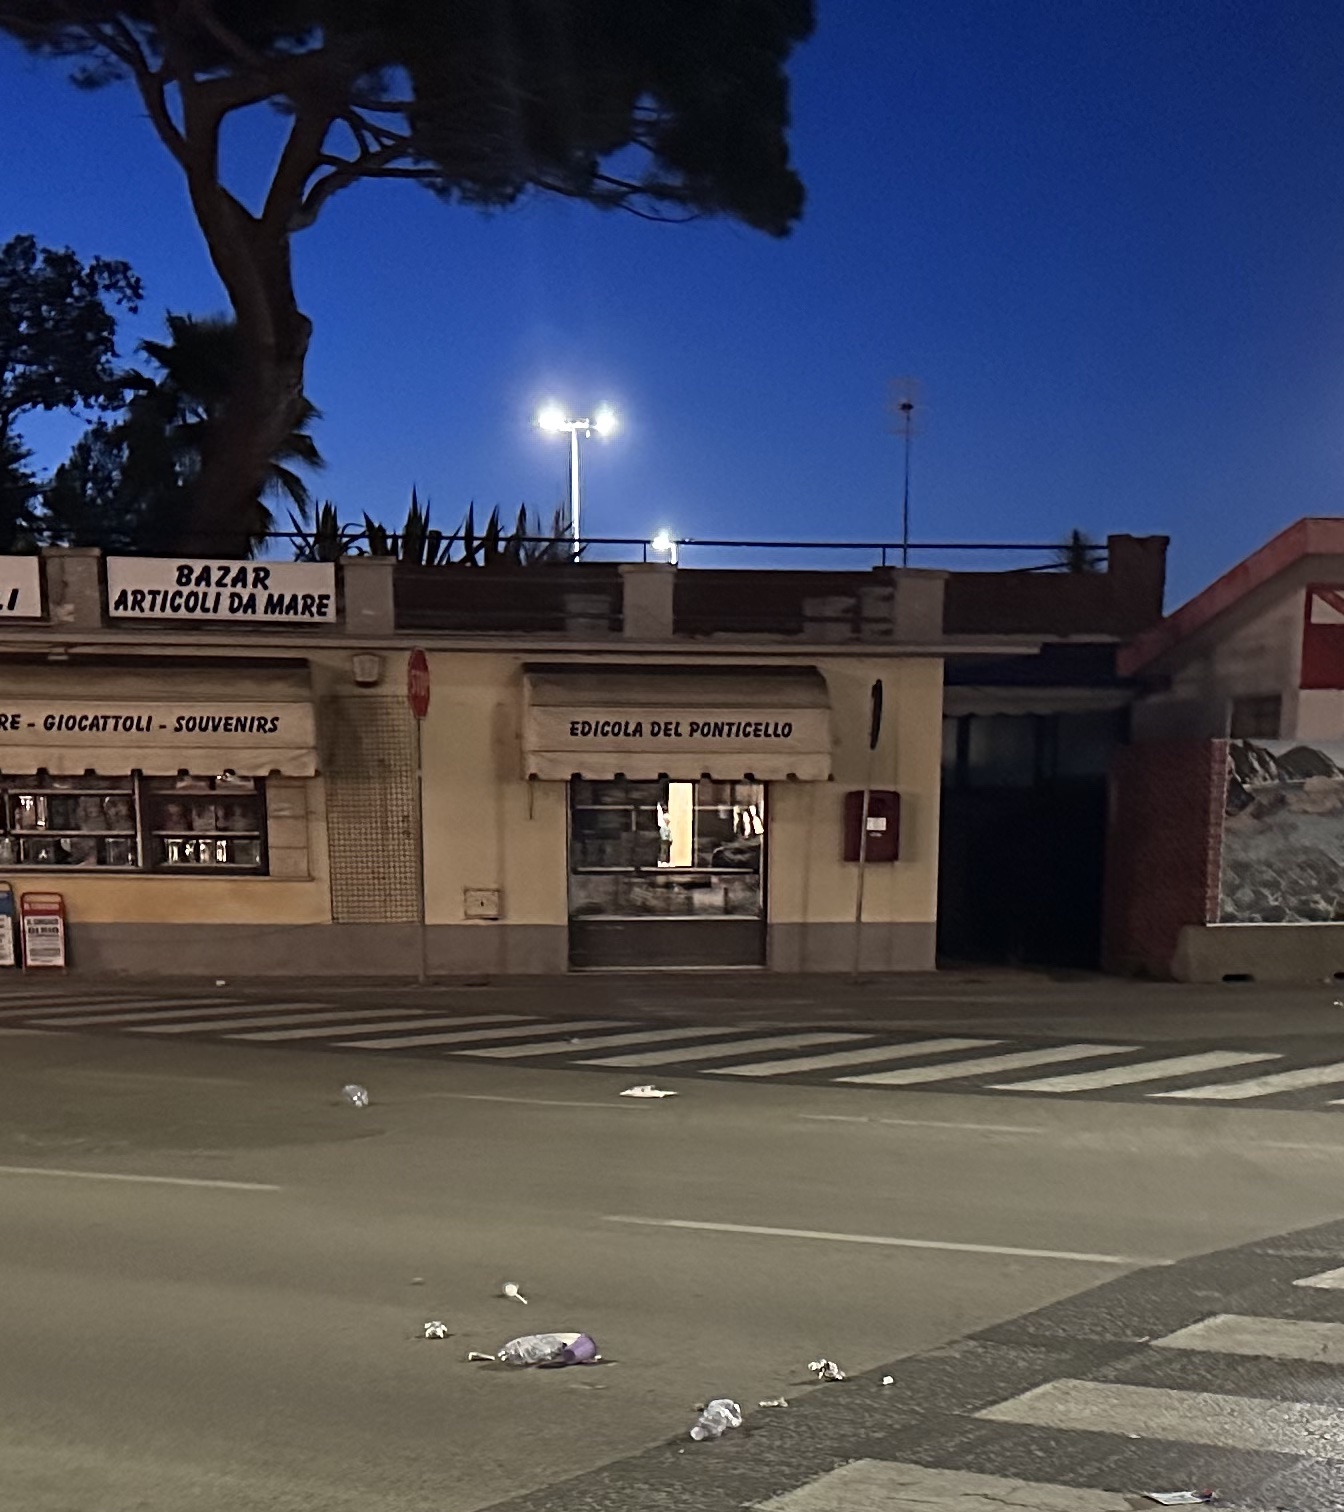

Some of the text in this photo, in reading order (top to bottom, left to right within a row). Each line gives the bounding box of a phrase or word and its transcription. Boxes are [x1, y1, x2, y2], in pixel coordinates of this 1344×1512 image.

[175, 564, 271, 590] BAZAR
[114, 589, 331, 618] ARTICOLI DA MARE
[43, 714, 153, 732] GIOCATTOLI
[174, 716, 280, 734] SOUVENIRS
[569, 720, 793, 738] EDICOLA DEL PONTICELLO
